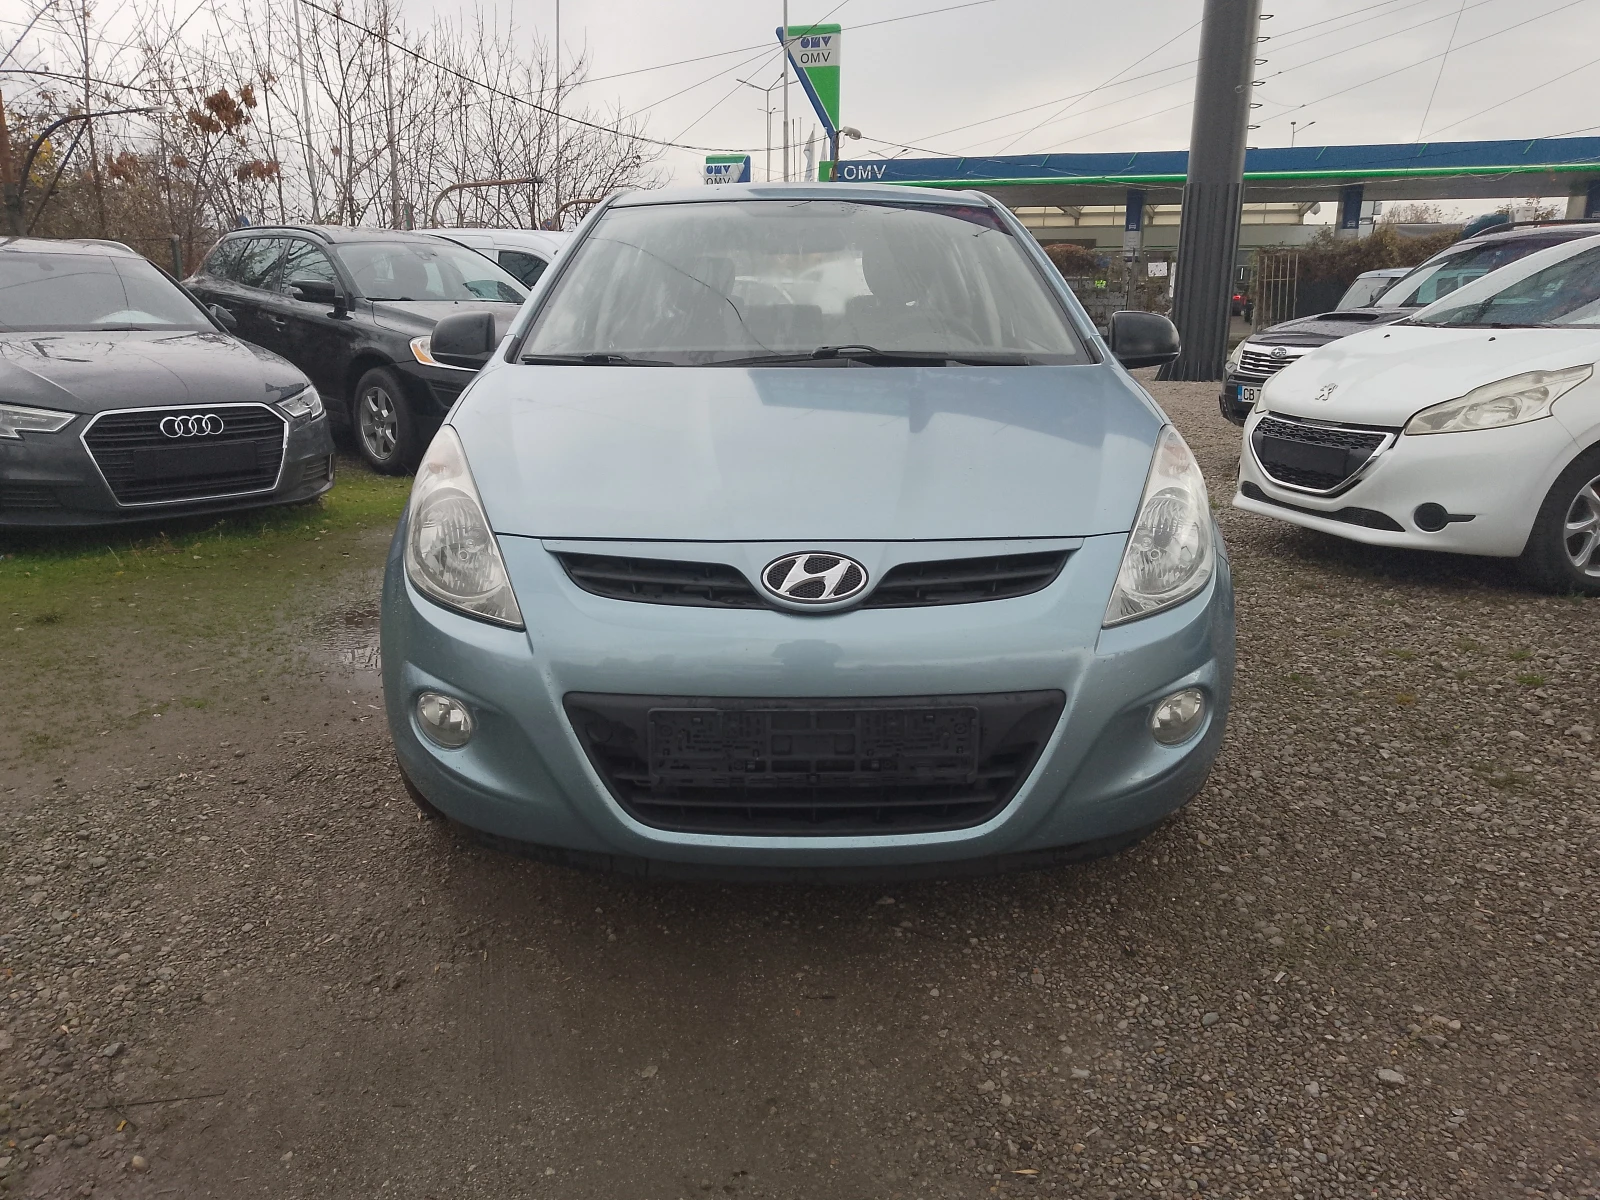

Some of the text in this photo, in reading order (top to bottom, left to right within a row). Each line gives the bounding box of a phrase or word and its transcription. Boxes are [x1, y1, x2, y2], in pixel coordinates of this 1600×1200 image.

[800, 52, 831, 64] OMV
[843, 164, 887, 180] OMV
[1243, 388, 1255, 401] CB
